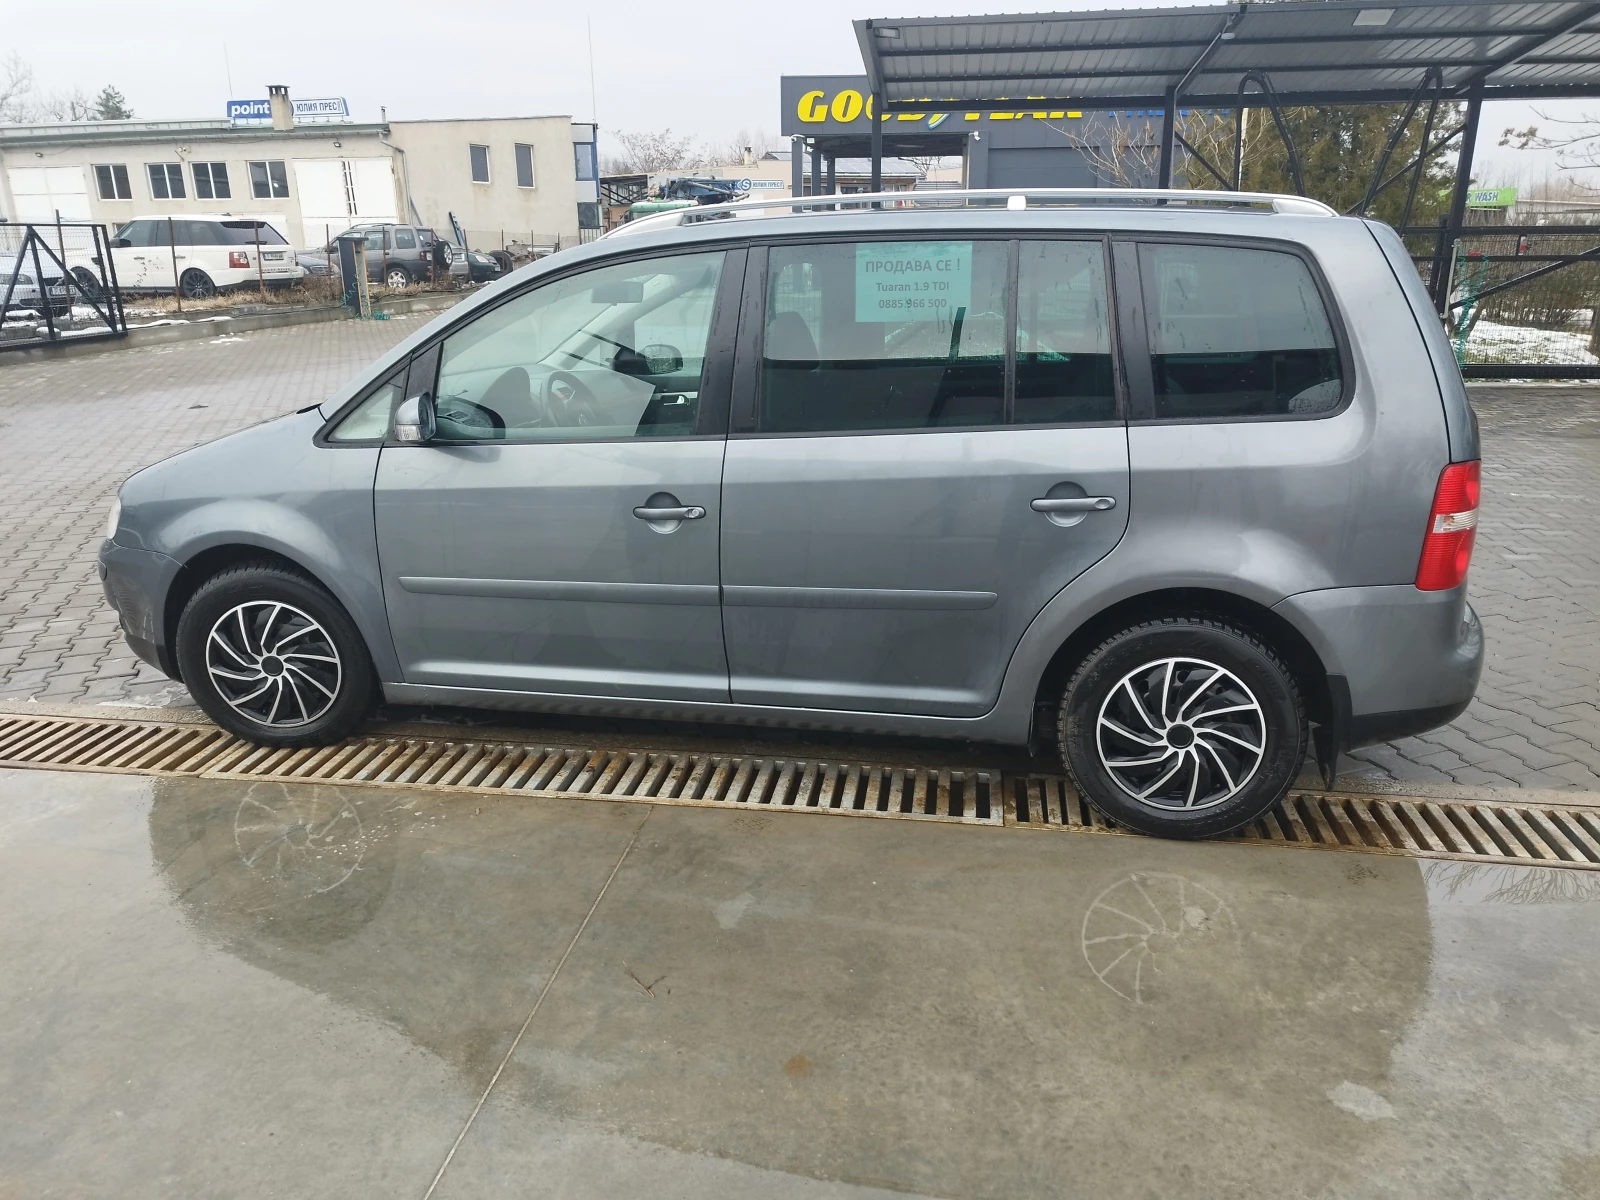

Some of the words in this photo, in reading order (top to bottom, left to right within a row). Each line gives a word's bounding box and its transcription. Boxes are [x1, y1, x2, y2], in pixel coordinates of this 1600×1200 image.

[231, 101, 270, 117] point
[296, 103, 317, 112] ЮЛИЯ
[319, 101, 337, 111] ПРЕС
[1475, 192, 1499, 201] WASH
[866, 260, 932, 274] ПРОДАВА
[936, 260, 952, 271] СЕ
[876, 282, 910, 291] Tuaran
[914, 282, 930, 291] 1.9
[932, 282, 950, 290] TDI
[878, 299, 903, 309] 0885
[906, 299, 925, 308] 966
[928, 298, 947, 308] 500
